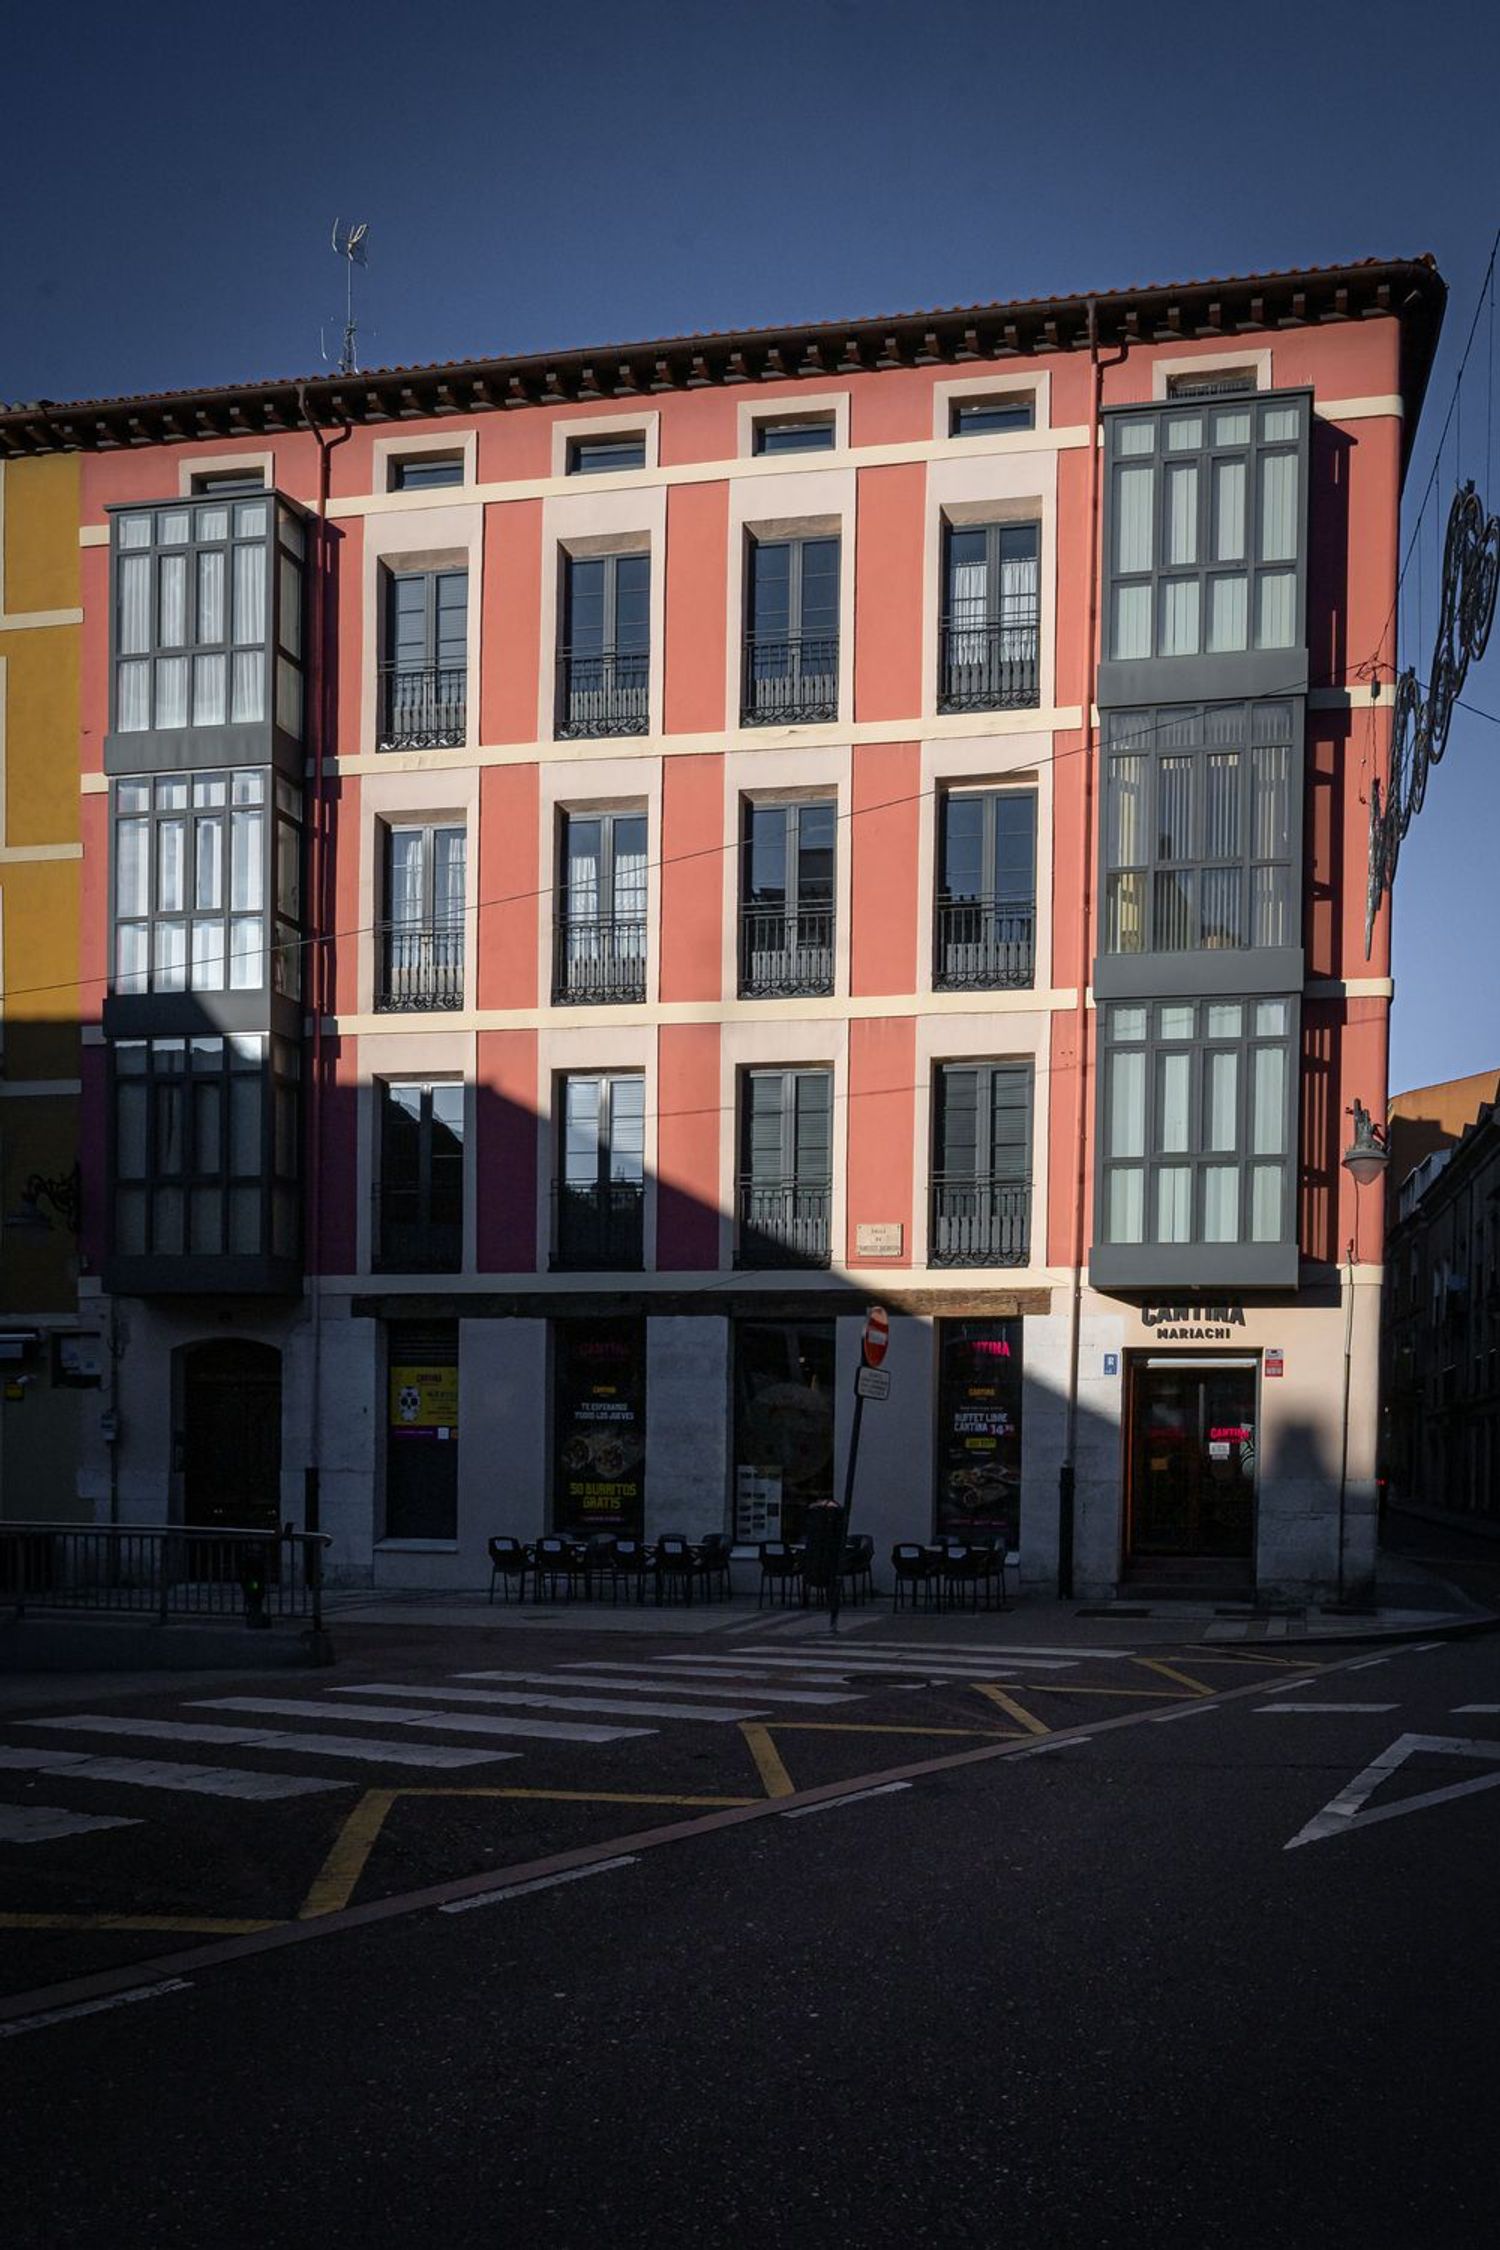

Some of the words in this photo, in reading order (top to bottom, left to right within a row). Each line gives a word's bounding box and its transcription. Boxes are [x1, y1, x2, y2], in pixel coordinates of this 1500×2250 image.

[1141, 1297, 1246, 1327] CANTINA
[1157, 1328, 1230, 1339] MARIACHI
[585, 1482, 637, 1496] BURRITOS
[583, 1496, 622, 1510] GRATIS
